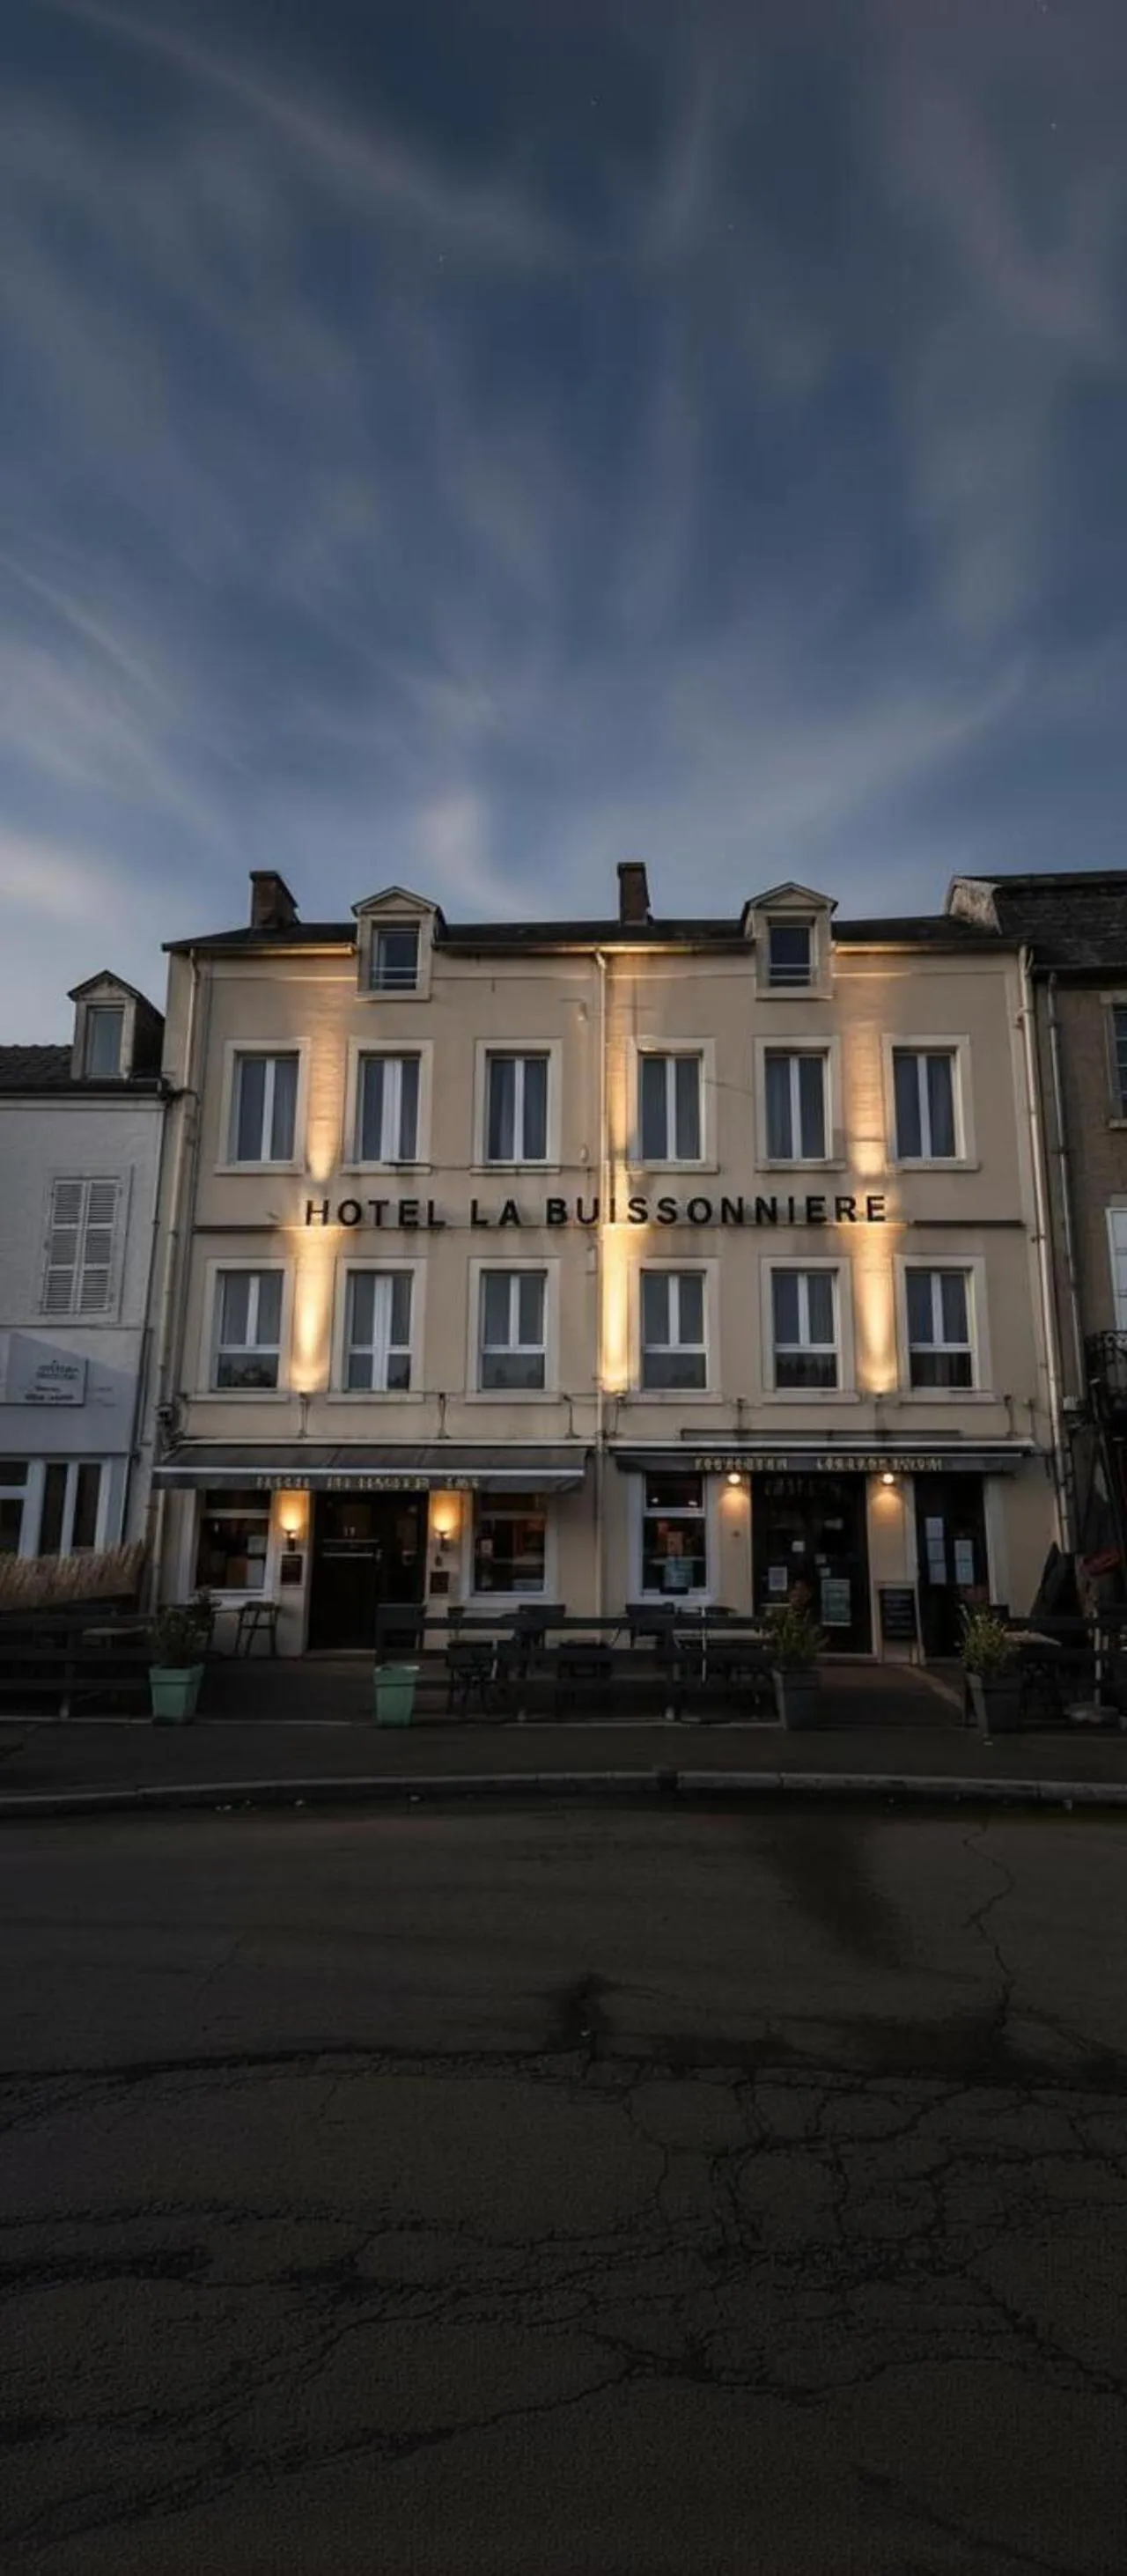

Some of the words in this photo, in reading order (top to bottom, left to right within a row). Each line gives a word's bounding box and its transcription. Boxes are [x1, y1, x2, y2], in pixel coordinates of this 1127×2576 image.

[306, 1198, 446, 1228] HOTEL
[471, 1198, 521, 1227] LA
[546, 1195, 887, 1226] BUISSONNIERE
